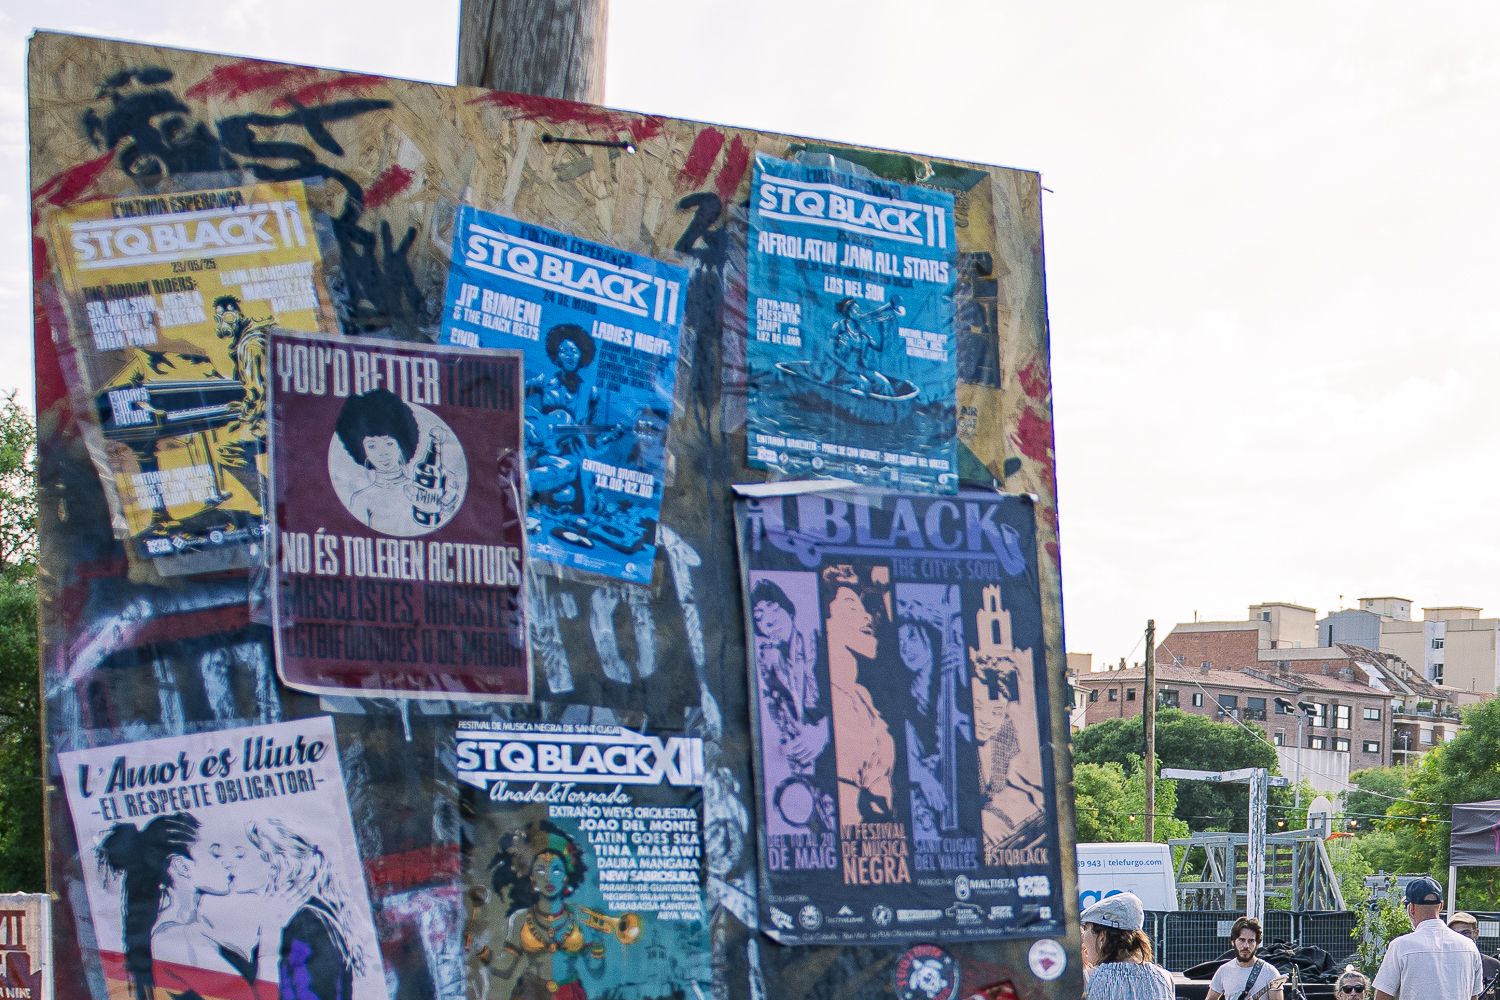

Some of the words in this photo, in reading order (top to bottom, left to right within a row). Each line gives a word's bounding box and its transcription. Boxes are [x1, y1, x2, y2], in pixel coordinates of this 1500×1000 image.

[758, 231, 836, 265] AFROLATIN
[840, 245, 874, 270] JAM
[875, 251, 900, 276] ALL
[903, 256, 950, 284] STARS
[824, 276, 844, 294] LOS
[845, 279, 863, 299] DEL
[865, 284, 885, 303] SON
[456, 283, 479, 306] JP
[481, 289, 541, 326] BIMENI
[464, 309, 482, 326] THE
[482, 315, 511, 334] BLACK
[512, 321, 540, 341] BELTS
[592, 320, 633, 344] LADIES
[276, 343, 349, 398] YOU'D
[583, 459, 616, 477] ENTRADA
[281, 532, 310, 575] NO
[314, 527, 339, 577] ÉS
[342, 535, 426, 582] TOLEREN
[427, 541, 523, 587] ACTITUDS
[891, 557, 917, 577] THE
[921, 558, 962, 580] CITY'S
[458, 721, 490, 730] FESTIVAL
[491, 722, 502, 731] DE
[534, 723, 562, 733] NEGRA
[563, 724, 574, 733] DE
[575, 724, 596, 734] SANT
[199, 745, 236, 778] és
[242, 735, 331, 771] lliure
[125, 784, 212, 817] RESPECTE
[549, 803, 600, 819] EXTRAÑO
[602, 806, 633, 819] WEYS
[634, 807, 697, 820] ORQUESTRA
[578, 819, 619, 832] JOAO
[622, 819, 647, 832] DEL
[649, 820, 698, 832] MONTE
[588, 832, 627, 844] LATIN
[631, 832, 669, 845] GOES
[673, 833, 700, 846] SKA
[842, 842, 857, 857] DE
[594, 844, 630, 857] TINA
[636, 845, 702, 858] MASAWI
[769, 848, 791, 871] DE
[793, 846, 837, 871] MAIG
[984, 847, 1048, 866] #STQBLACK
[597, 857, 636, 869] DAURA
[639, 858, 700, 870] MANGARA
[843, 857, 911, 886] NEGRA
[1087, 860, 1102, 868] 943
[1108, 859, 1162, 868] telefurgo.com
[599, 870, 628, 882] NEW
[6, 987, 31, 999] NINE
